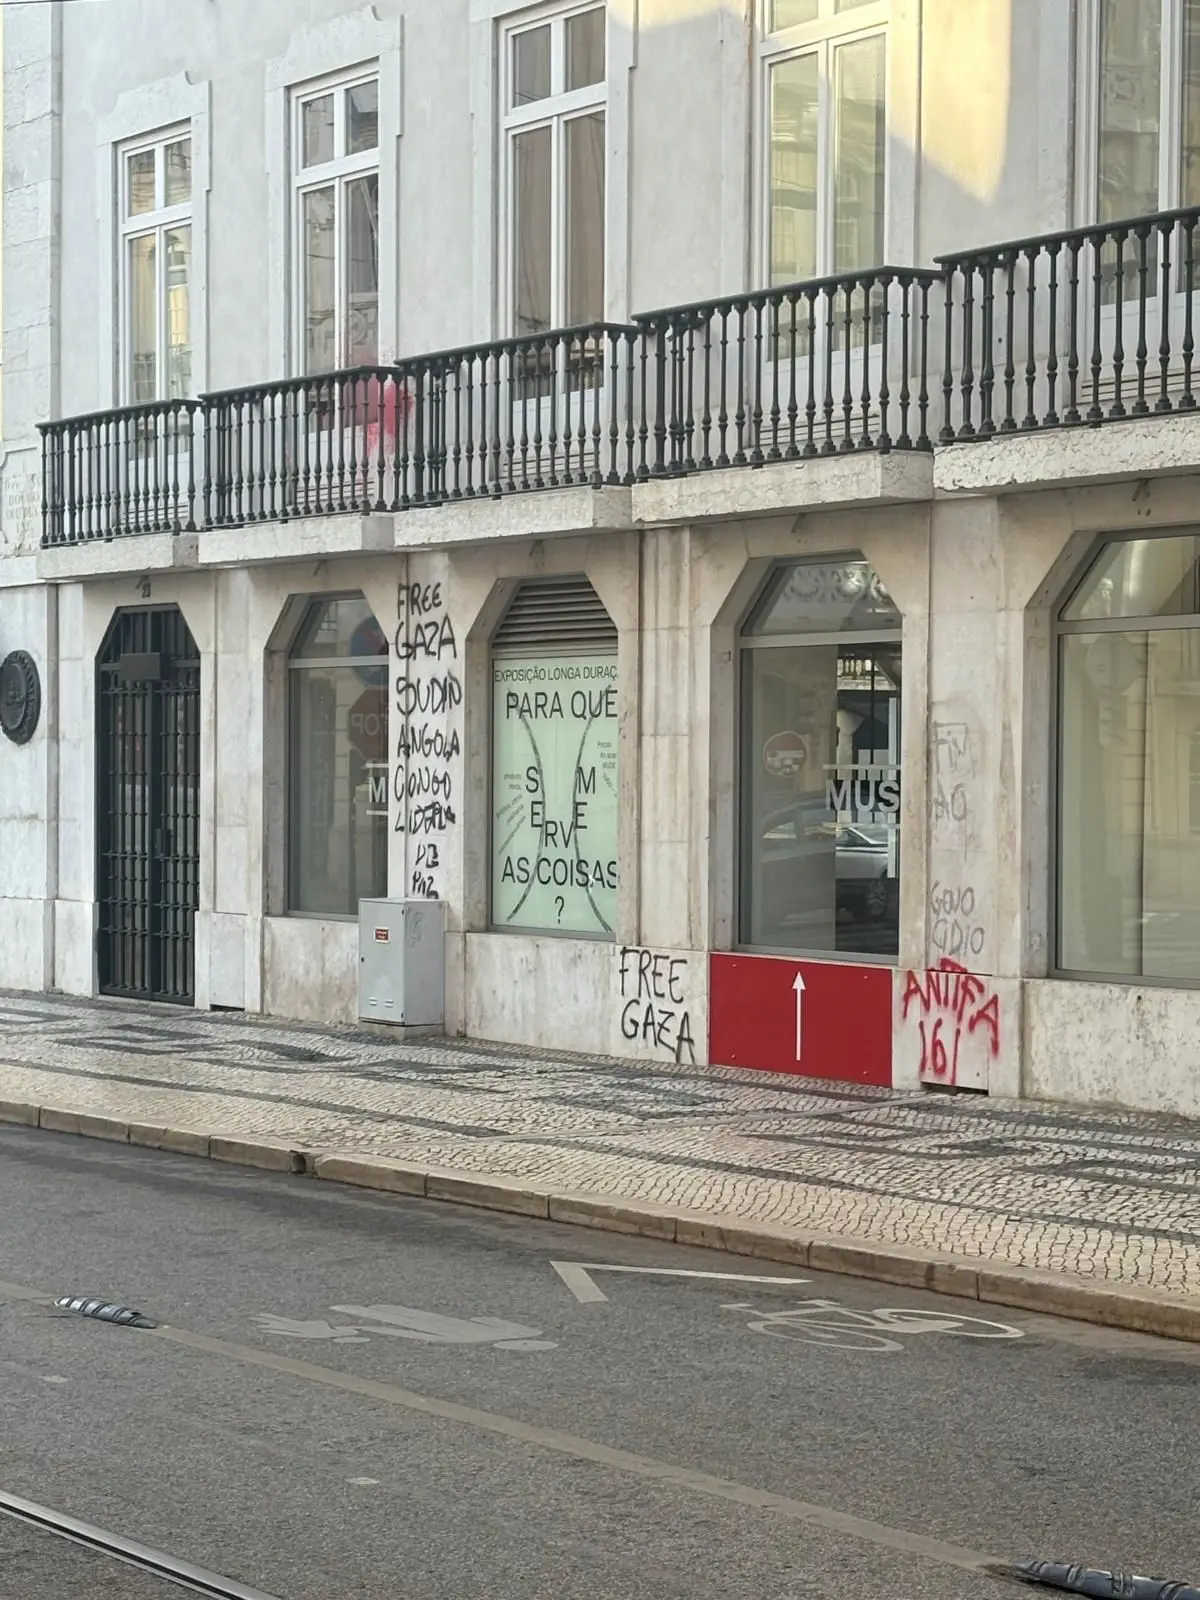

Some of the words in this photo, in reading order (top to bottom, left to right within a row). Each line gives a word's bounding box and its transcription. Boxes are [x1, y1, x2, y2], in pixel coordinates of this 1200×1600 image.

[398, 582, 442, 619] FREE
[395, 612, 457, 661] GAZA
[494, 666, 546, 684] EXPOSIÇÃO
[547, 667, 582, 681] LONGA
[506, 690, 564, 719] PARA
[397, 723, 460, 762] ANGOLA
[394, 765, 451, 801] CONGO
[501, 856, 530, 884] AS
[536, 857, 617, 889] COISAS
[554, 895, 565, 924] ?
[619, 946, 688, 1004] FREE
[902, 957, 999, 1058] ANTIFA
[621, 999, 695, 1064] GAZA
[918, 1018, 961, 1085] 161
